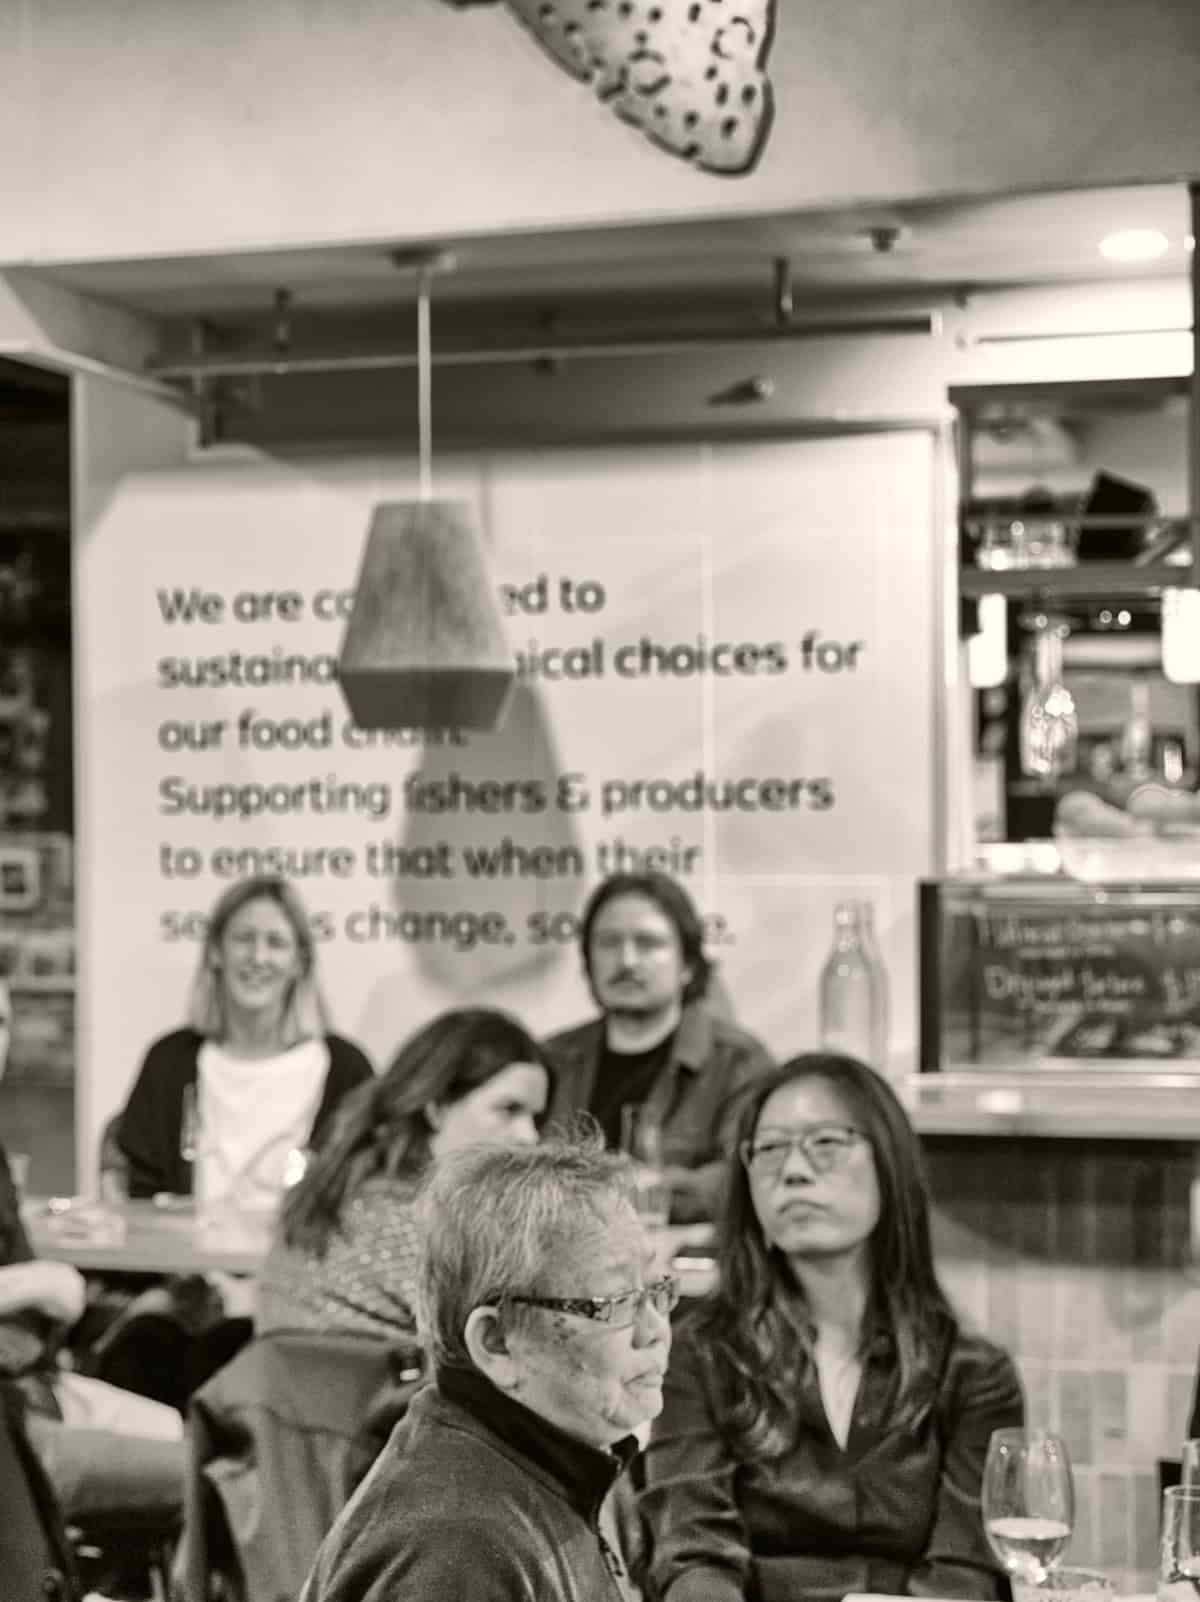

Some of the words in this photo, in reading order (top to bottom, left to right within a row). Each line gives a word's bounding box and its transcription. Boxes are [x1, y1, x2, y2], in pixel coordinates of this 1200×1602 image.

[157, 587, 224, 625] We
[233, 590, 304, 622] are
[560, 577, 606, 613] to
[158, 645, 340, 688] sustaina
[614, 632, 788, 677] choices
[801, 628, 865, 673] for
[158, 719, 227, 752] our
[238, 708, 332, 751] food
[159, 773, 392, 822] Supporting
[404, 772, 548, 814] fishers
[557, 774, 590, 813] &
[602, 769, 835, 818] producers
[159, 842, 203, 880] to
[211, 847, 356, 879] ensure
[366, 838, 453, 879] that
[462, 836, 583, 879] when
[596, 836, 703, 876] their
